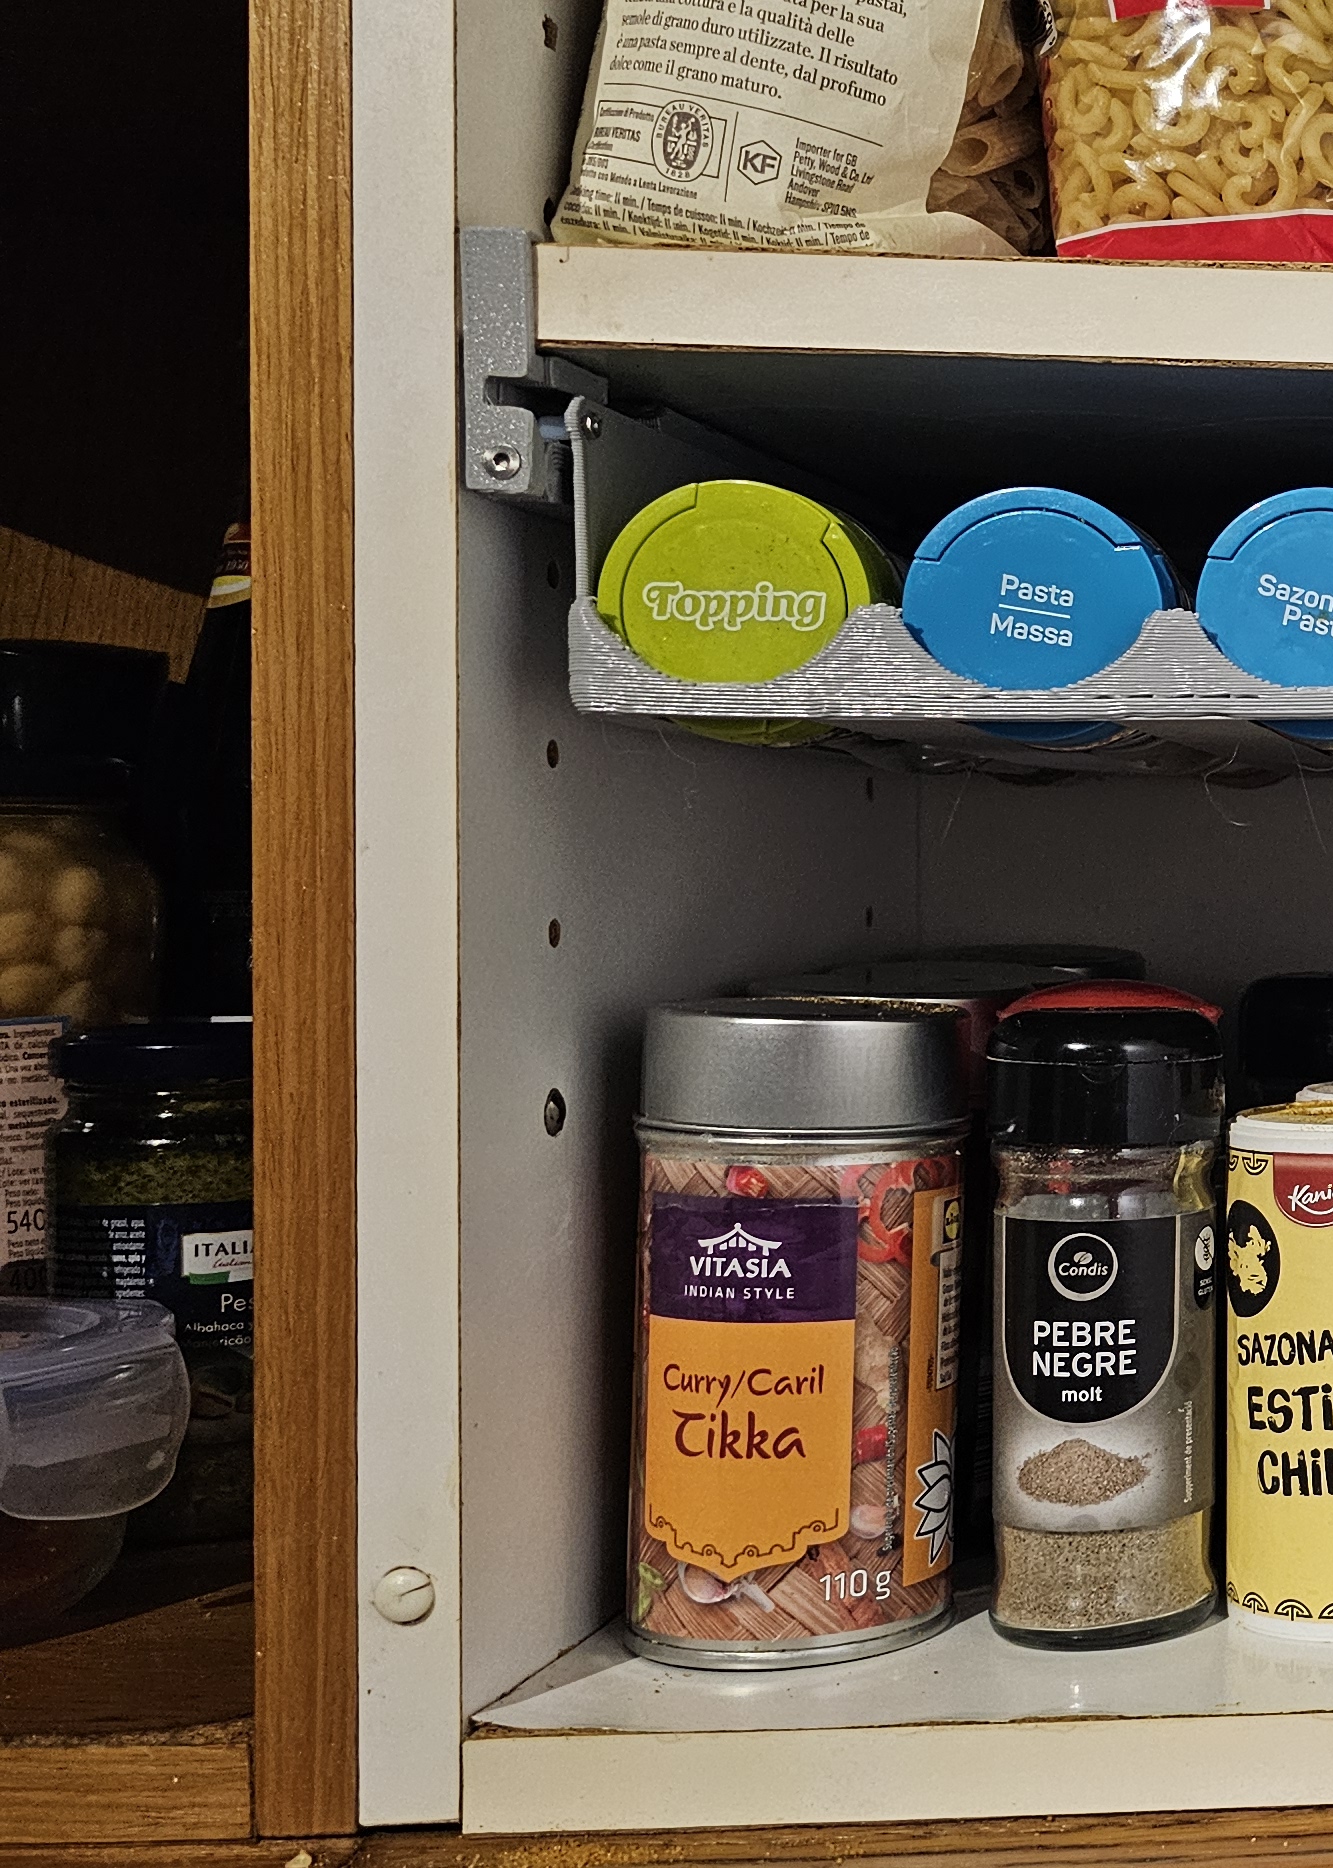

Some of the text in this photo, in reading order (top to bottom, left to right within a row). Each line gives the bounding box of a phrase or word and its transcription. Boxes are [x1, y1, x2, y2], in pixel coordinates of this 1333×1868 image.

[810, 0, 838, 18] per
[840, 4, 854, 24] la
[857, 14, 884, 32] sua
[855, 0, 906, 18] astai,
[728, 2, 736, 14] e
[740, 0, 753, 18] la
[756, 8, 812, 34] qualità
[816, 22, 855, 47] delle
[652, 10, 664, 26] di
[664, 14, 699, 30] grano
[701, 17, 734, 38] duro
[738, 28, 815, 60] utilizzate.
[818, 46, 832, 64] Il
[833, 54, 898, 86] risultato
[610, 54, 782, 99] dolce come il grano maturo.
[638, 34, 667, 52] pasta
[669, 40, 720, 60] sempre
[722, 47, 736, 64] al
[740, 50, 788, 78] dente,
[792, 64, 818, 84] dal
[818, 75, 887, 106] profumo
[742, 150, 778, 174] KF
[796, 137, 831, 158] Importer
[832, 148, 844, 162] for
[666, 168, 690, 178] 1828
[790, 164, 836, 189] Livingstone
[818, 159, 840, 177] Wood
[788, 178, 820, 198] Andover
[1000, 573, 1075, 608] Pasta
[642, 580, 827, 632] Topping
[990, 612, 1074, 648] Massa
[7, 1208, 46, 1234] 540
[194, 1240, 254, 1258] ITALI
[689, 1255, 792, 1279] VITASIA
[1058, 1262, 1108, 1277] Condis
[684, 1284, 796, 1300] INDIAN STYLE
[1032, 1319, 1136, 1348] PEBRE
[1032, 1349, 1137, 1378] NEGRE
[662, 1362, 826, 1408] Curry/Caril
[1061, 1385, 1102, 1402] molt
[672, 1408, 806, 1460] Tikka
[819, 1568, 892, 1600] 110 g
